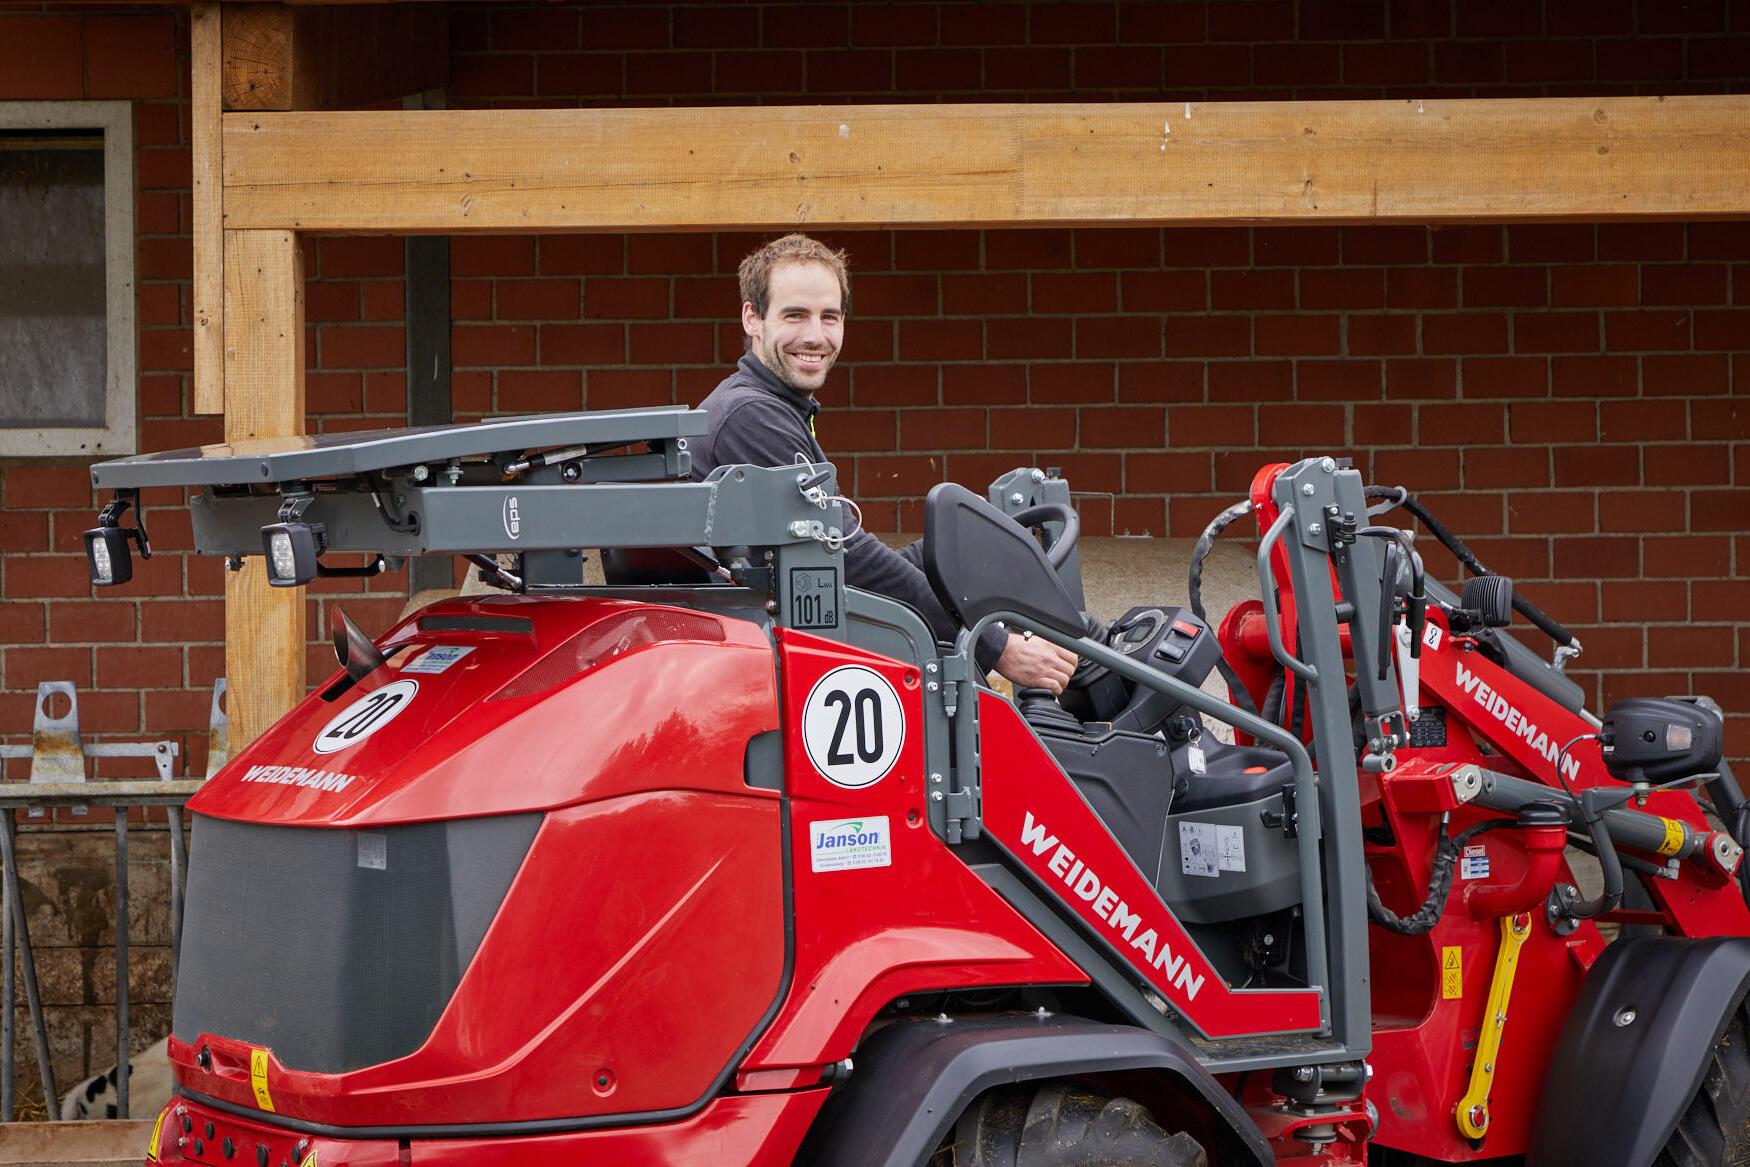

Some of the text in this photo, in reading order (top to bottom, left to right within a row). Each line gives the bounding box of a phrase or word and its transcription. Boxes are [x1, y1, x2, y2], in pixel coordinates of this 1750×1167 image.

[509, 497, 520, 533] eps
[795, 594, 834, 624] 101 dB
[325, 692, 404, 740] 20
[824, 688, 884, 766] 20
[1455, 661, 1581, 781] WEIDEMANN
[241, 765, 357, 793] WEIDEMANN
[816, 832, 879, 849] Janson
[1020, 811, 1206, 1001] WEIDEMANN
